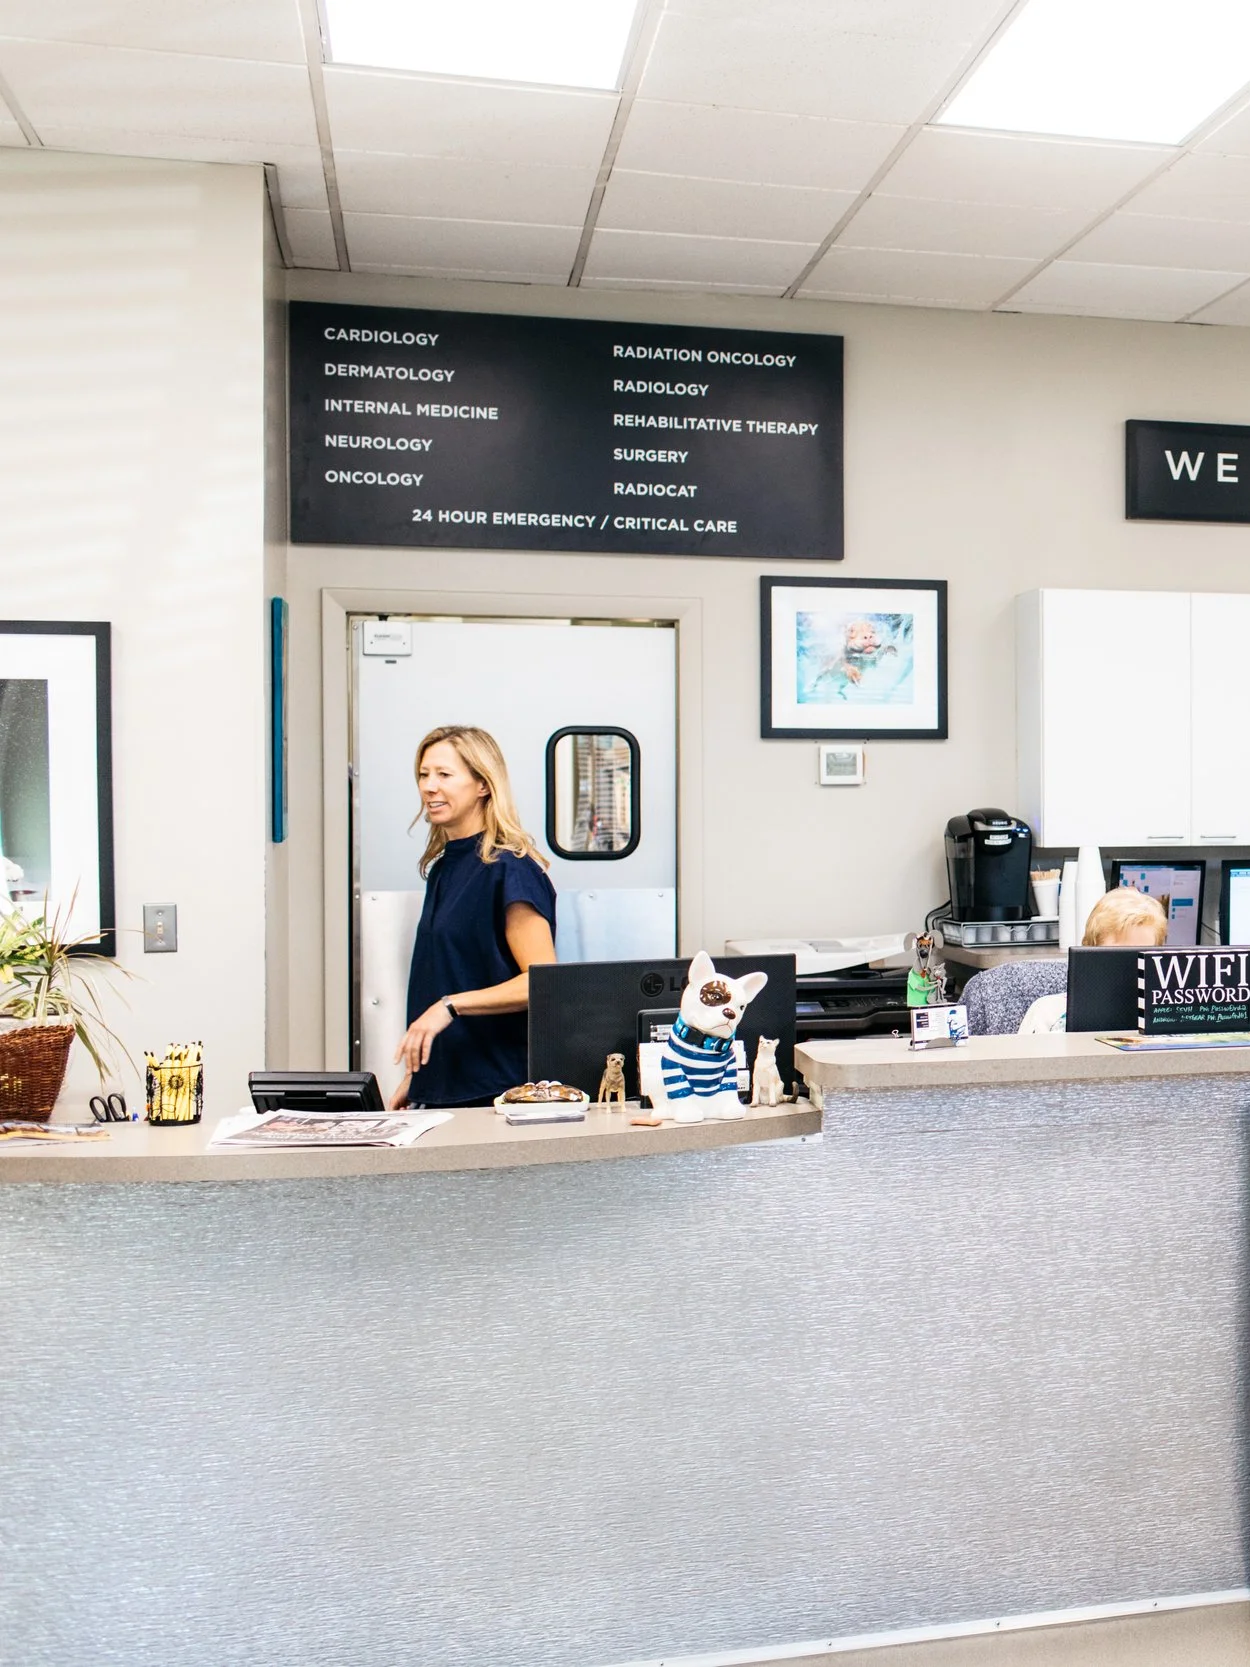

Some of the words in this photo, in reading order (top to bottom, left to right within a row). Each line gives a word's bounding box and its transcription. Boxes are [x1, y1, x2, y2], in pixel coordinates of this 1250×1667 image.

[324, 327, 439, 346] CARDIOLOGY
[613, 345, 702, 362] RADIATION
[706, 350, 796, 367] ONCOLOGY
[324, 363, 455, 383] DERMATOLOGY
[613, 379, 709, 397] RADIOLOGY
[324, 399, 412, 416] INTERNAL
[416, 403, 499, 420] MEDICINE
[613, 413, 742, 432] REHABILITATIVE
[746, 420, 819, 436] THERAPY
[324, 434, 433, 452] NEUROLOGY
[613, 447, 689, 464] SURGERY
[1164, 450, 1239, 483] WE
[324, 470, 424, 487] ONCOLOGY
[613, 482, 698, 498] RADIOCAT
[411, 508, 433, 522] 24
[438, 509, 488, 524] HOUR
[492, 511, 596, 528] EMERGENCY
[599, 514, 610, 530] /
[613, 516, 690, 532] CRITICAL
[693, 519, 738, 534] CARE
[1151, 953, 1249, 989] WIFI
[1152, 987, 1250, 1005] PASSWORD
